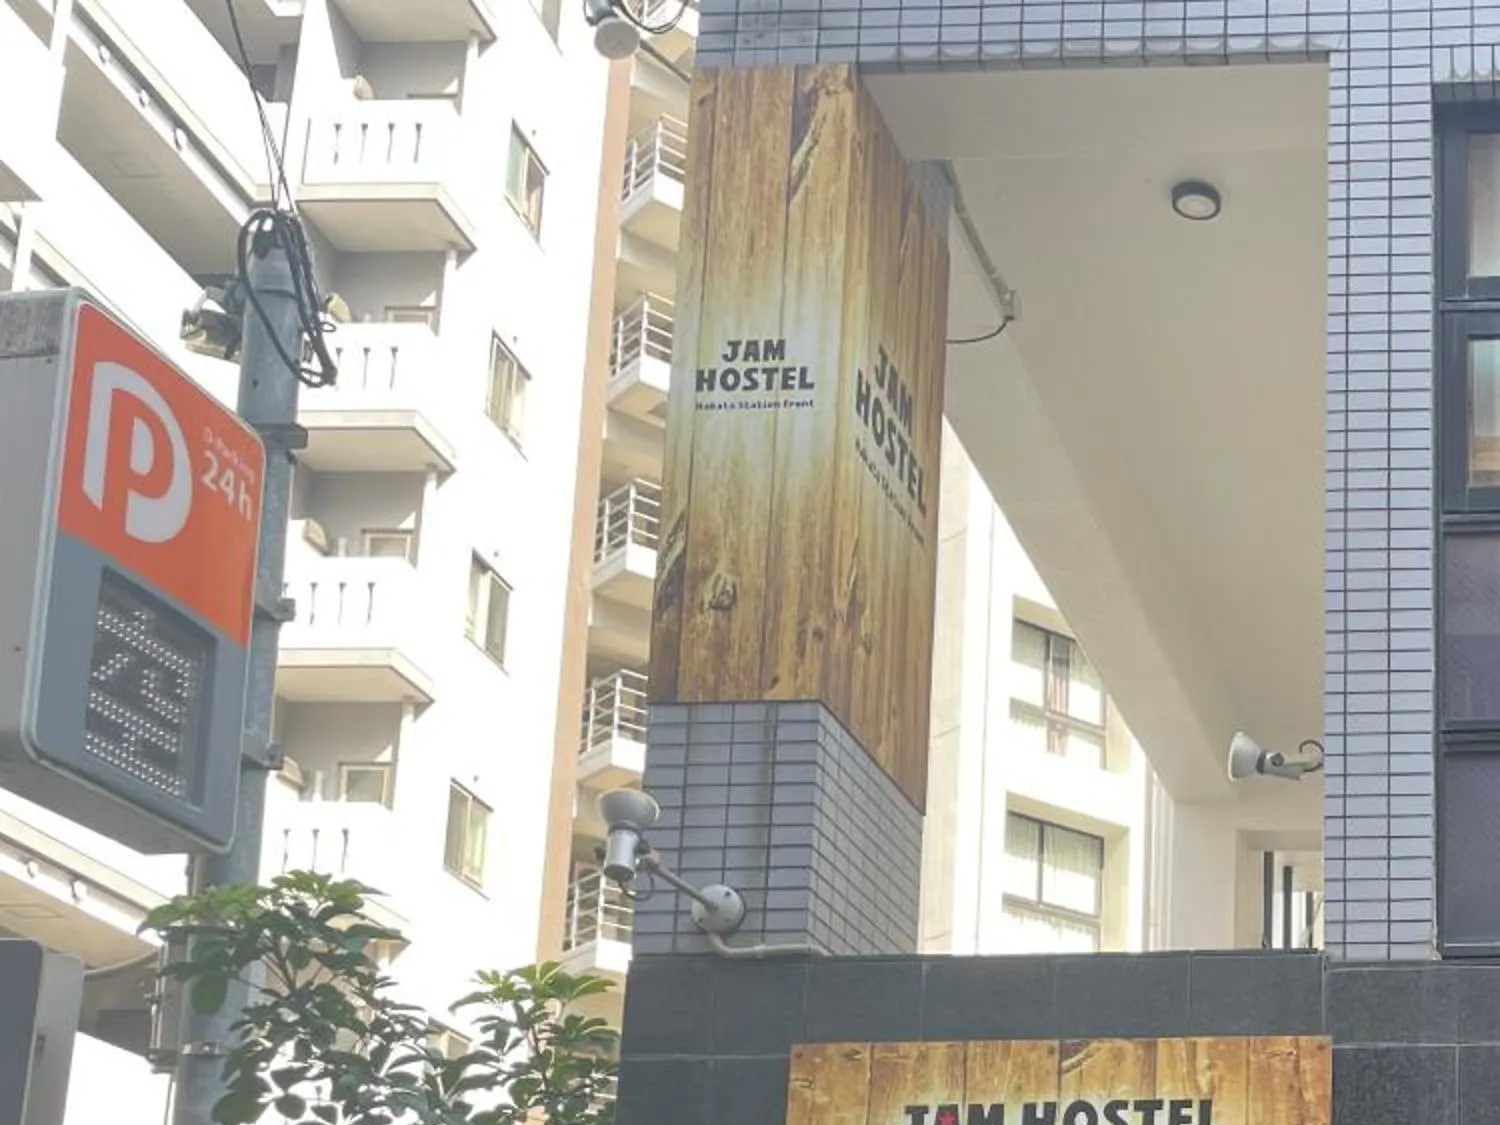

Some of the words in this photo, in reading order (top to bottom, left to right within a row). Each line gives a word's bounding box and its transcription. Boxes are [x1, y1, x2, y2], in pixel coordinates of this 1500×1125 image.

[695, 366, 815, 392] HOSTEL
[722, 338, 786, 362] JAM
[874, 344, 913, 440] JAM
[82, 361, 192, 543] P
[202, 449, 253, 521] 24h
[855, 368, 927, 518] HOSTEL
